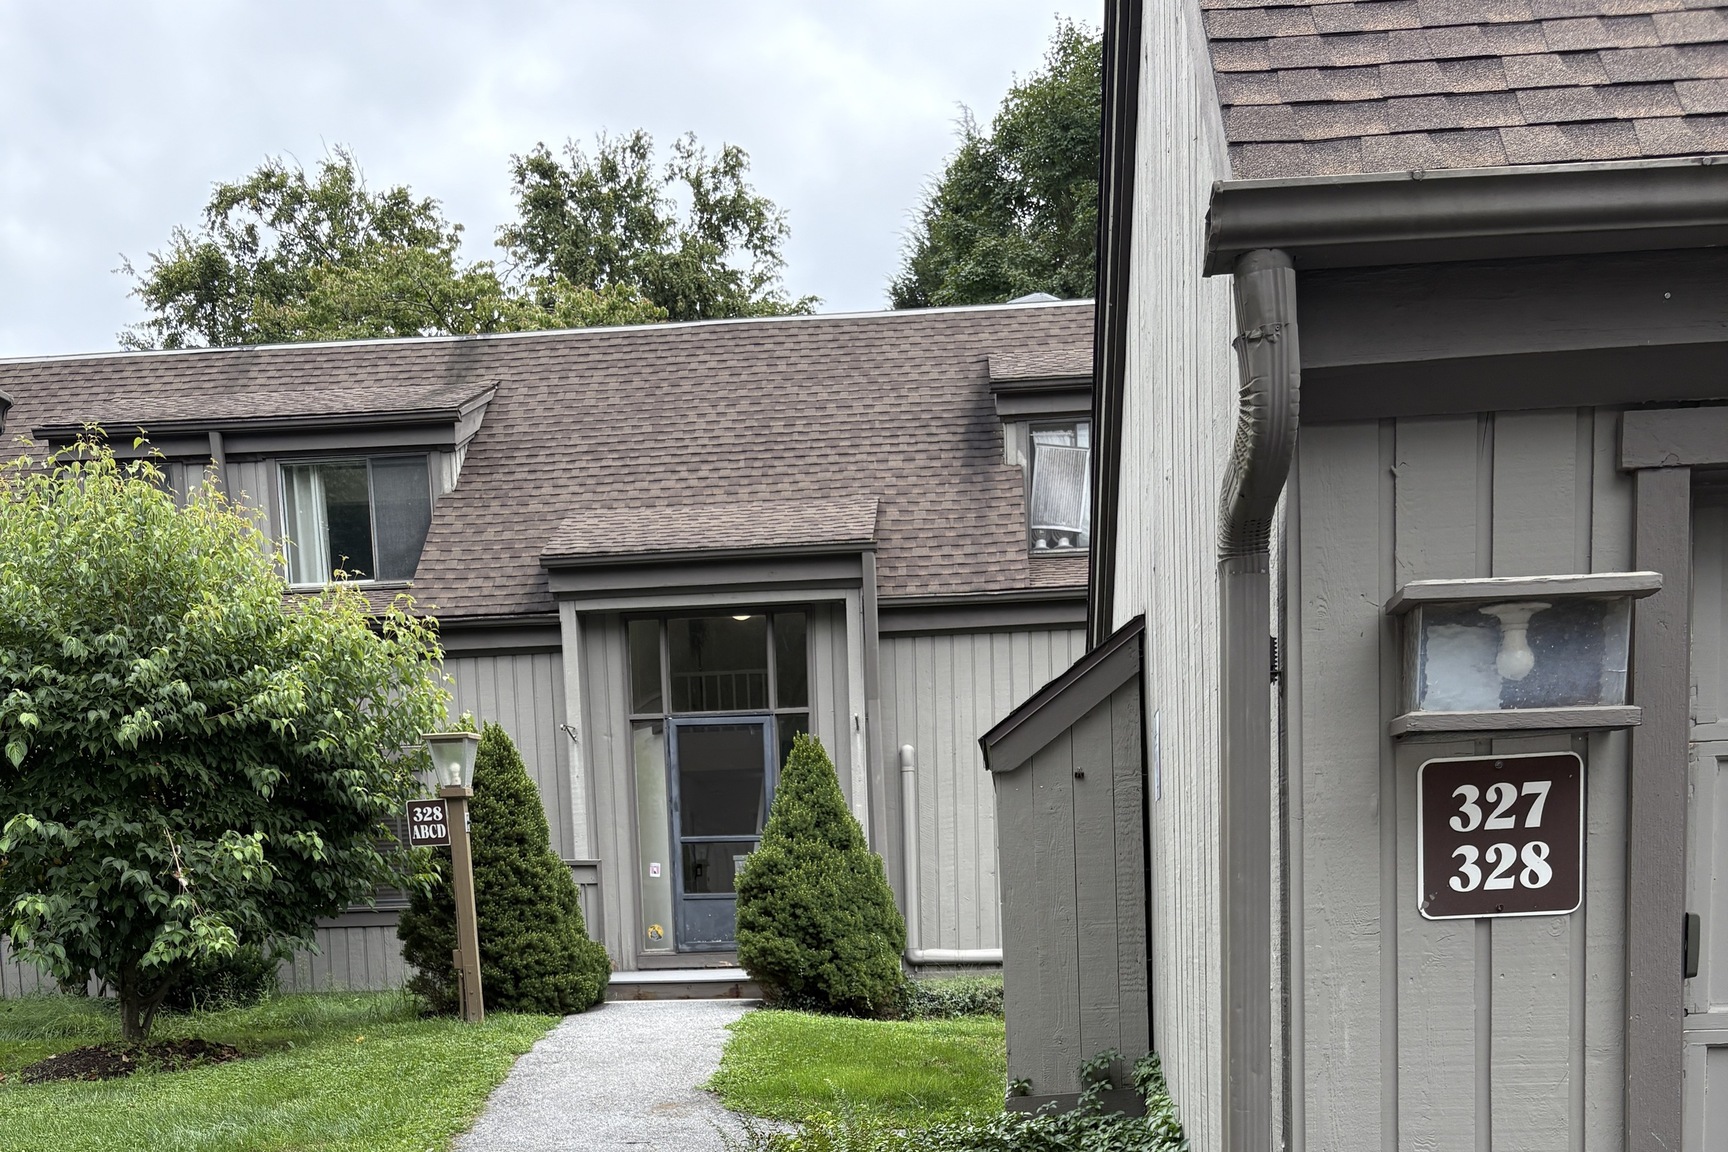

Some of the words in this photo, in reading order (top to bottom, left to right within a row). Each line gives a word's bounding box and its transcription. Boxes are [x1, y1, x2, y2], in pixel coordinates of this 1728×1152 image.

[413, 806, 443, 822] 328
[1449, 780, 1552, 832] 327
[412, 824, 446, 839] ABCD
[1449, 841, 1553, 892] 328
